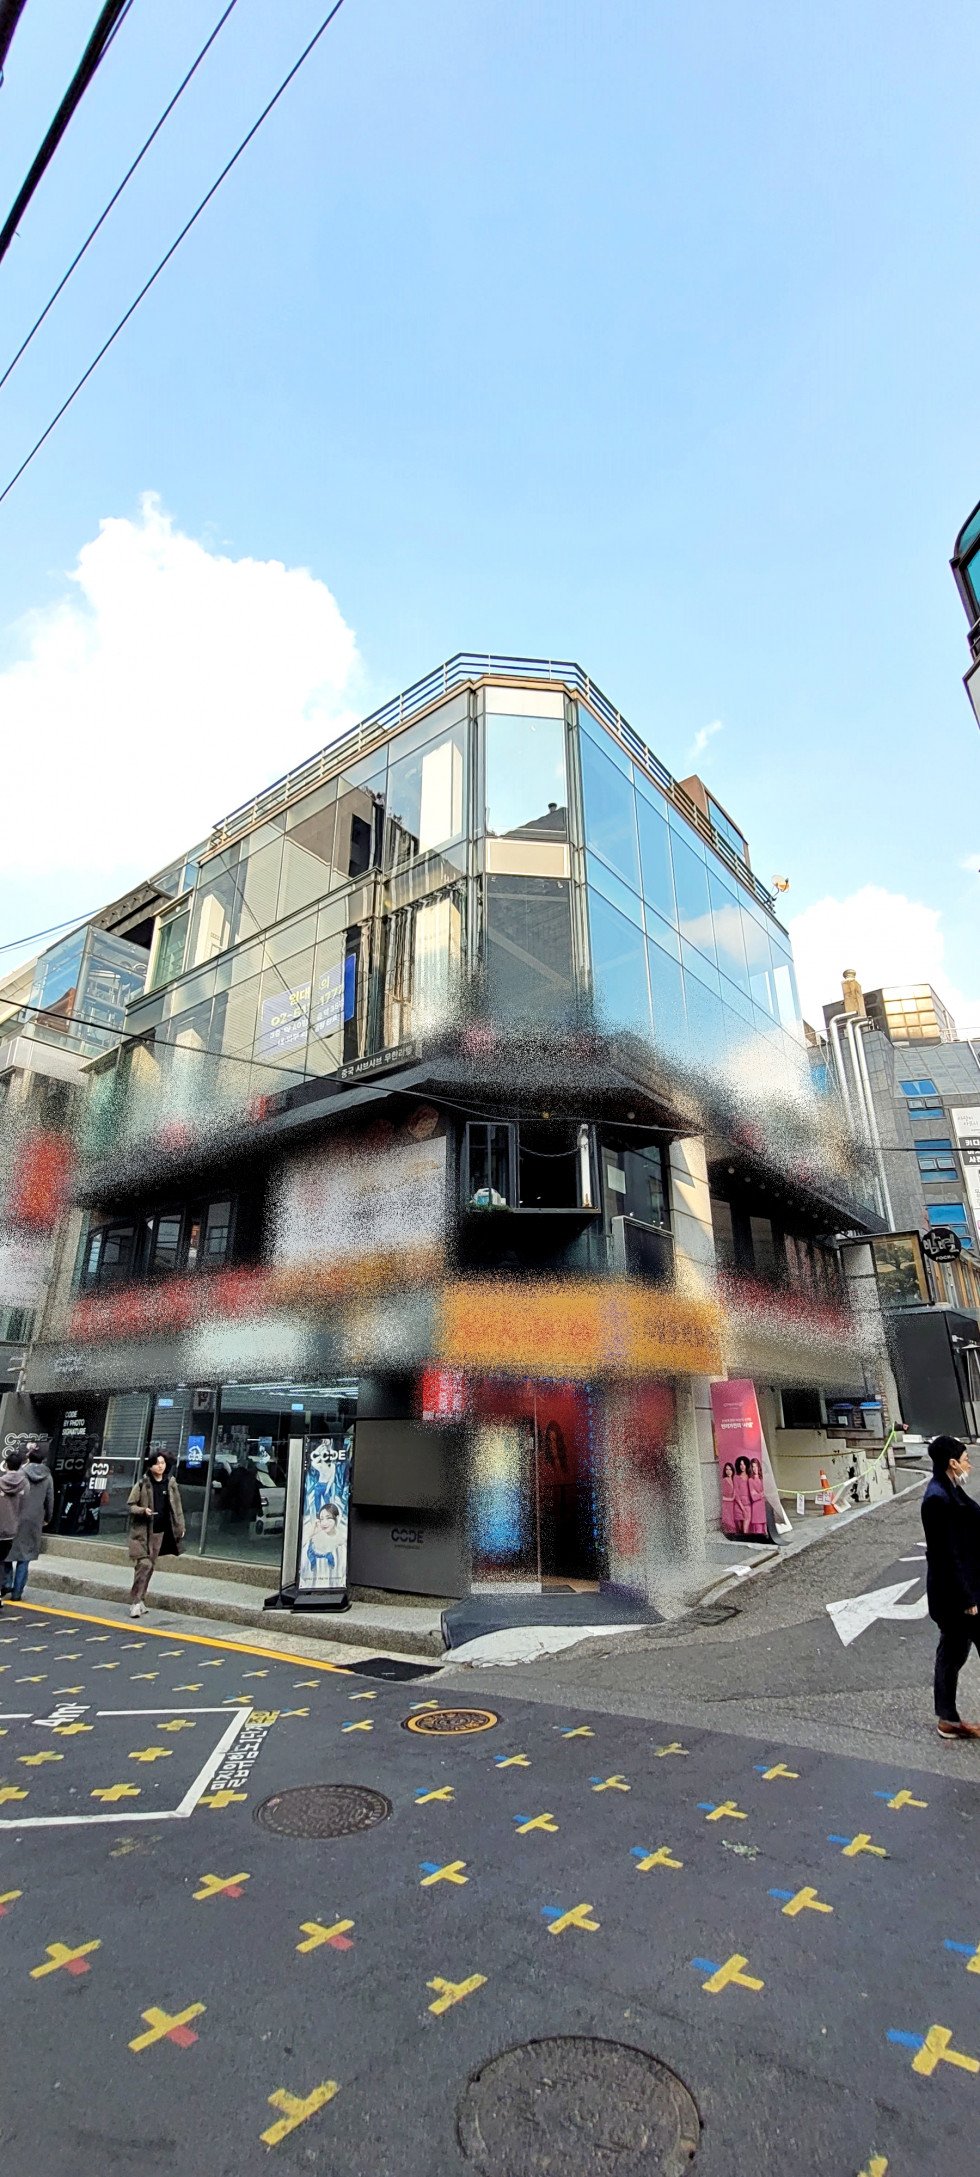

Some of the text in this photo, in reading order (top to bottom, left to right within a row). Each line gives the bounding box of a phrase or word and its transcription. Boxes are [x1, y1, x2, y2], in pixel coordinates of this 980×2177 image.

[341, 1066, 354, 1079] 중국
[70, 1418, 86, 1427] PHOTO
[310, 1449, 347, 1461] CODE
[391, 1528, 424, 1544] CODE
